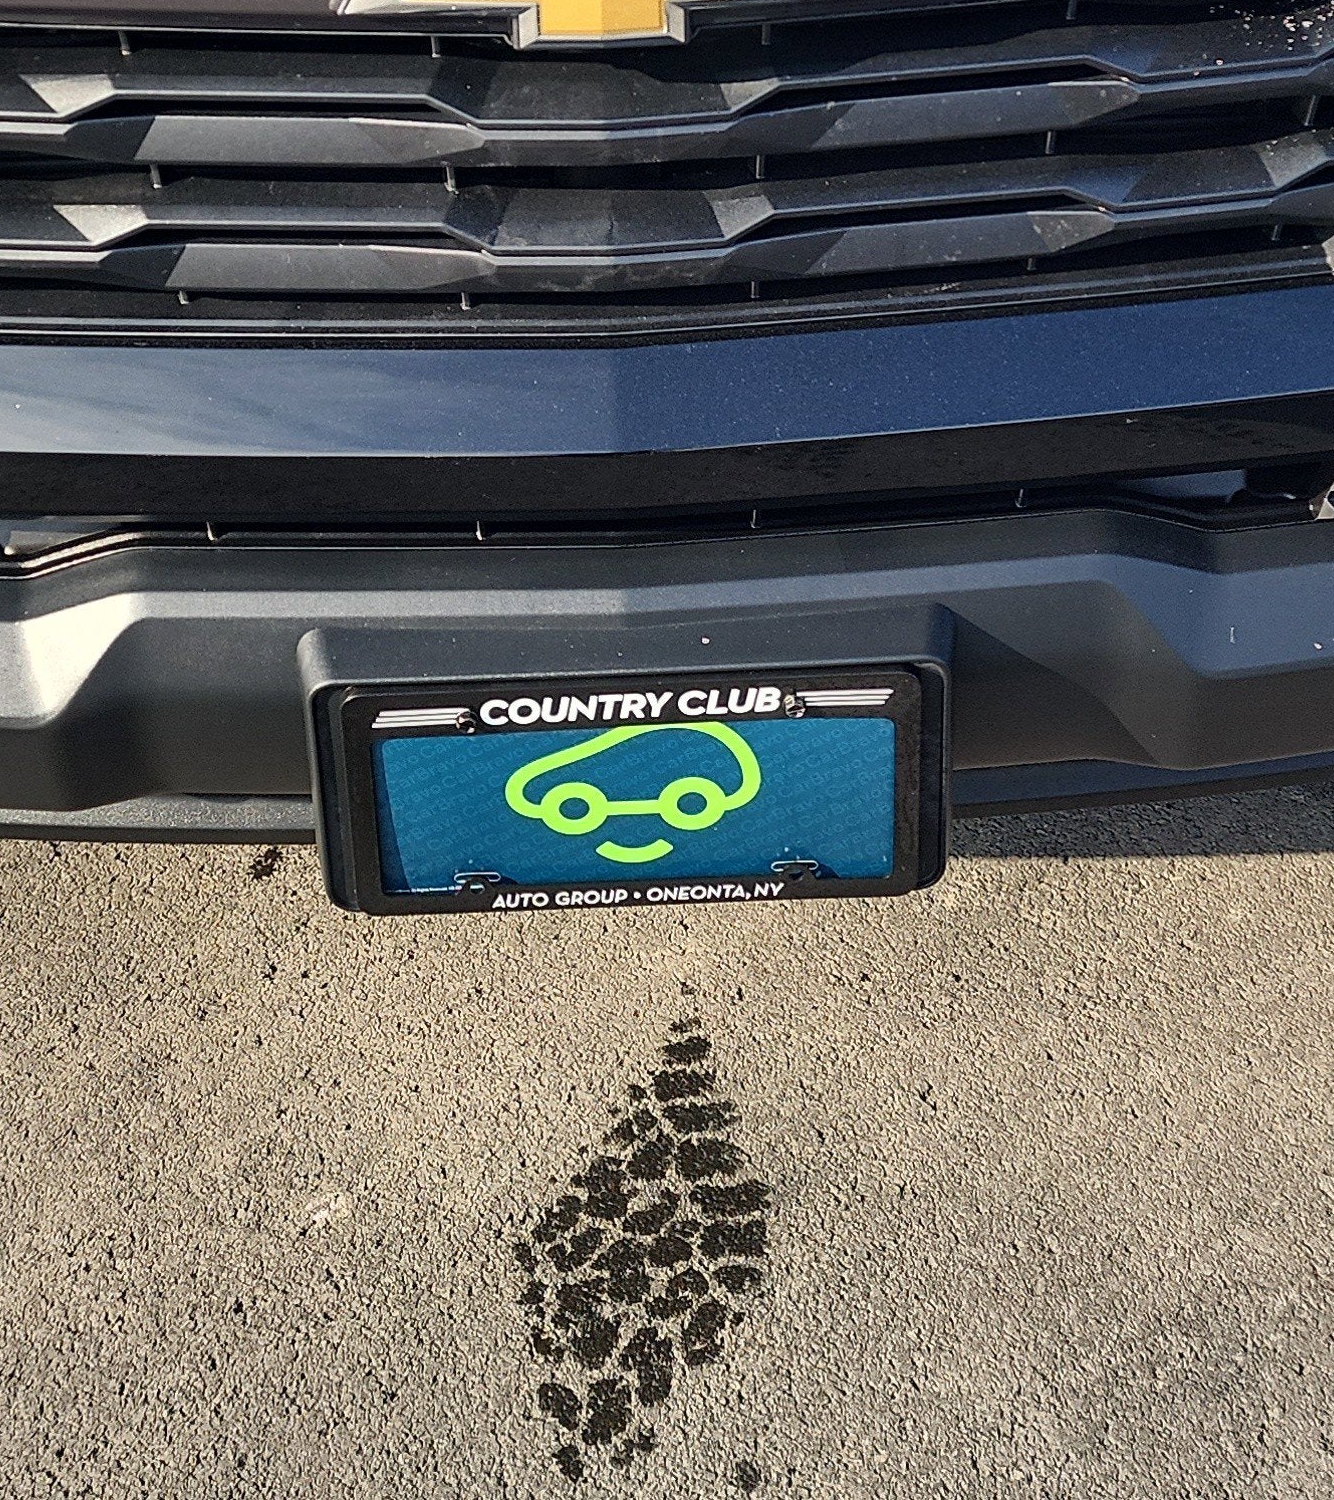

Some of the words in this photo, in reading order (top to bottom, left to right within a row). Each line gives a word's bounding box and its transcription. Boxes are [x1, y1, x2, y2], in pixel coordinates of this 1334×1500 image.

[479, 691, 673, 726] COUNTRY
[677, 687, 782, 716] CLUB
[492, 891, 549, 909] AUTO
[555, 889, 628, 906] GROUP
